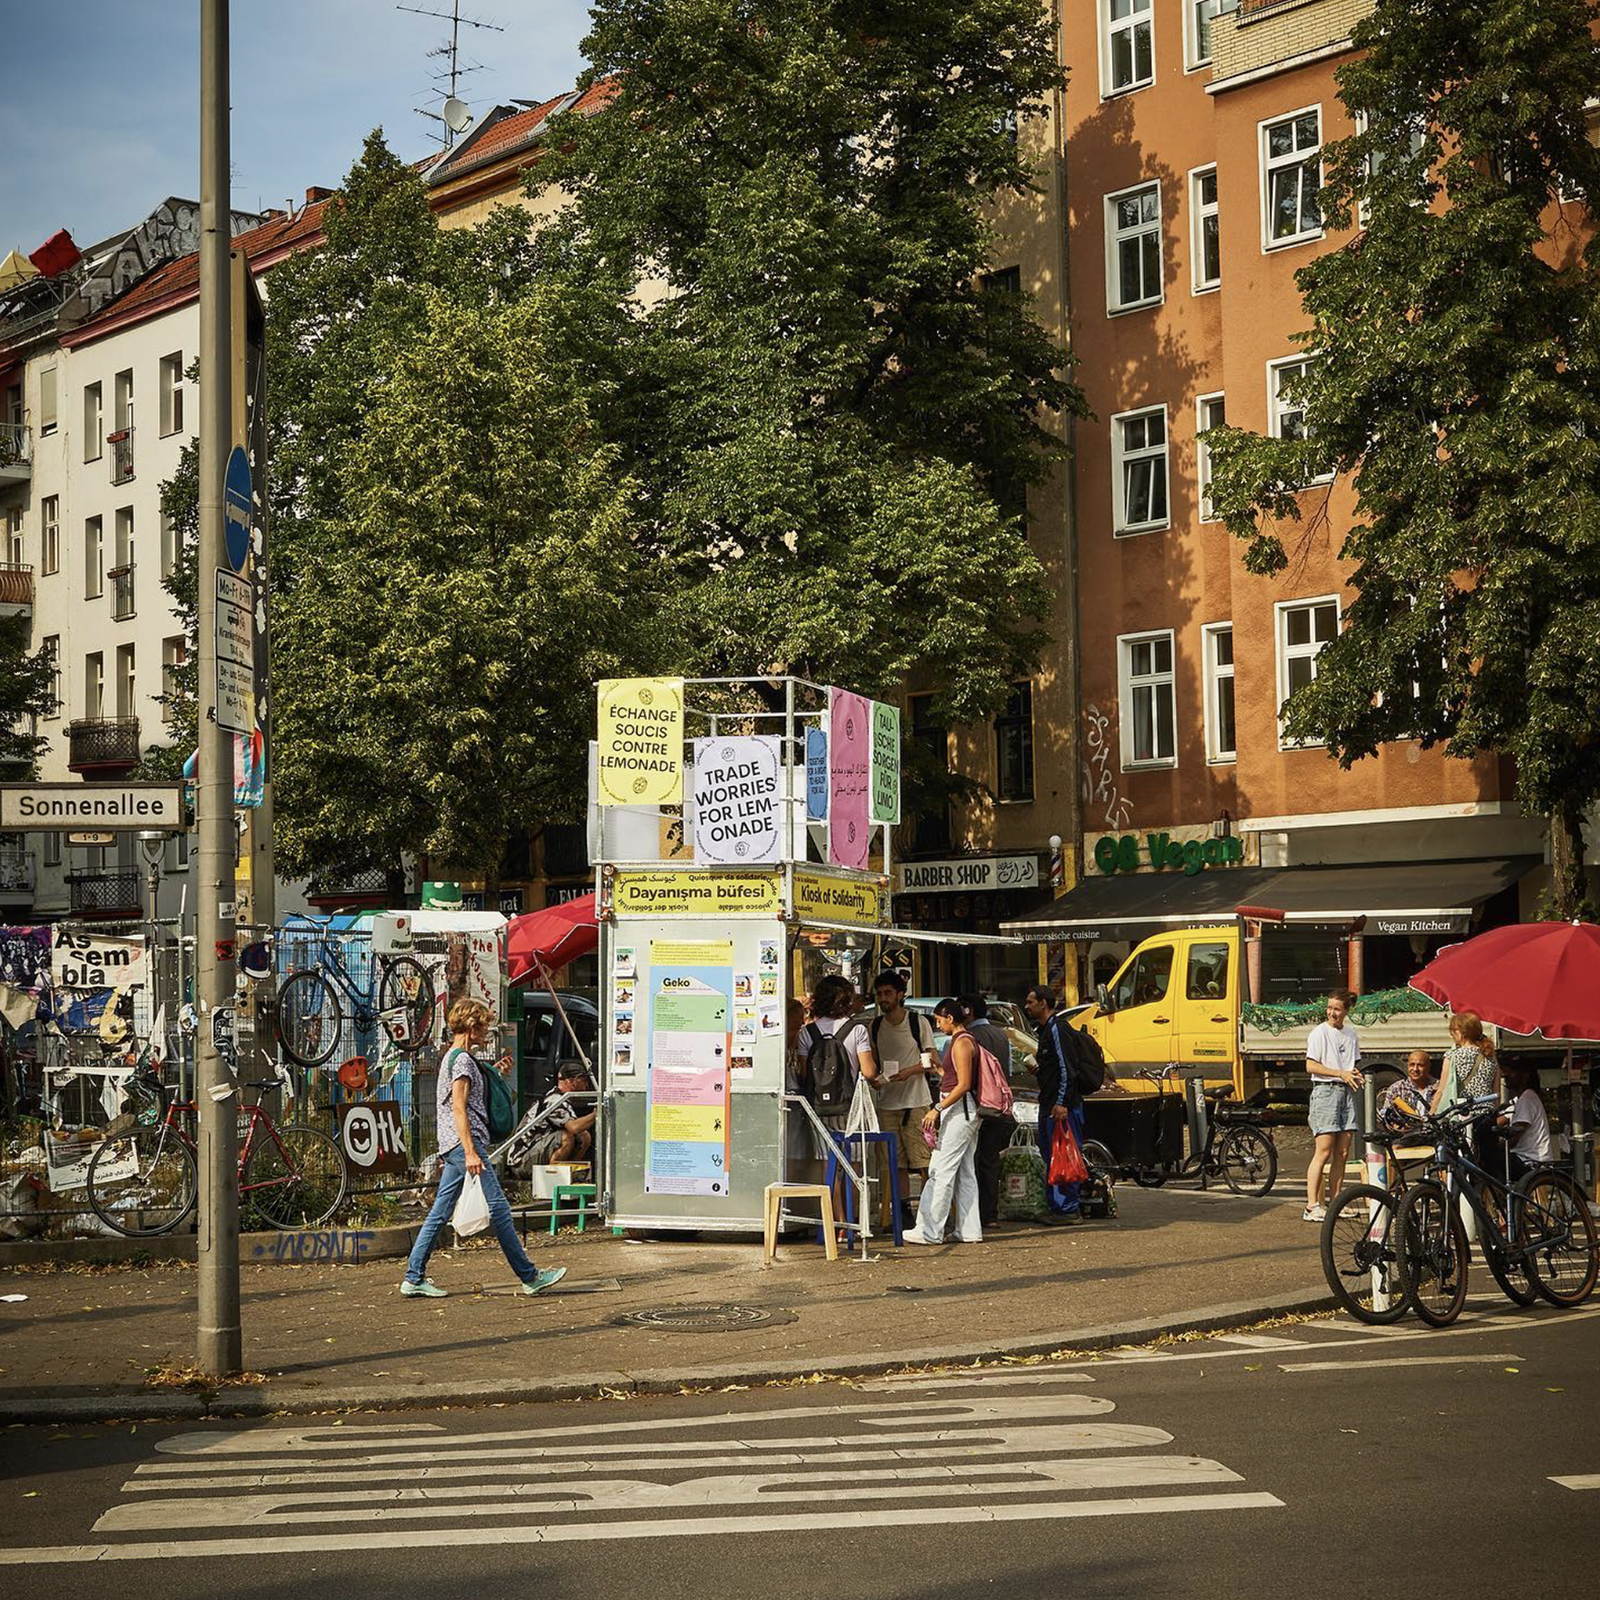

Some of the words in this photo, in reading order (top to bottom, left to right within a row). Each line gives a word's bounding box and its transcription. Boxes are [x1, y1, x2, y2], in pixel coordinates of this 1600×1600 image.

[610, 704, 677, 722] ÉCHANGE
[615, 723, 668, 738] SOUCIS
[612, 740, 668, 755] CONTRE
[600, 756, 676, 773] LEMONADE
[873, 751, 898, 774] SORGEN
[705, 761, 760, 785] TRADE
[880, 770, 892, 788] FÜR
[695, 777, 776, 806] WORRIES
[19, 793, 164, 816] Sonnenallee
[877, 794, 894, 810] LIMO
[699, 806, 733, 826] FOR
[737, 797, 779, 817] LEM-
[82, 834, 99, 842] 1-9
[711, 817, 774, 842] ONADE
[1146, 832, 1243, 877] Vegan
[688, 874, 724, 883] Quiosque
[904, 866, 954, 887] BARBER
[957, 864, 991, 885] SHOP
[630, 886, 712, 901] Dayanışma
[717, 884, 765, 899] büfesi
[801, 884, 822, 903] Kiosk
[823, 888, 831, 905] of
[832, 888, 866, 912] Solidarity
[461, 897, 477, 911] afé
[1072, 931, 1101, 940] cuisine
[1378, 920, 1408, 934] Vegan
[1411, 920, 1451, 931] Kitchen
[55, 932, 91, 949] As
[473, 938, 493, 953] the
[70, 948, 130, 966] sem
[62, 964, 105, 985] bla
[663, 977, 690, 987] Geko
